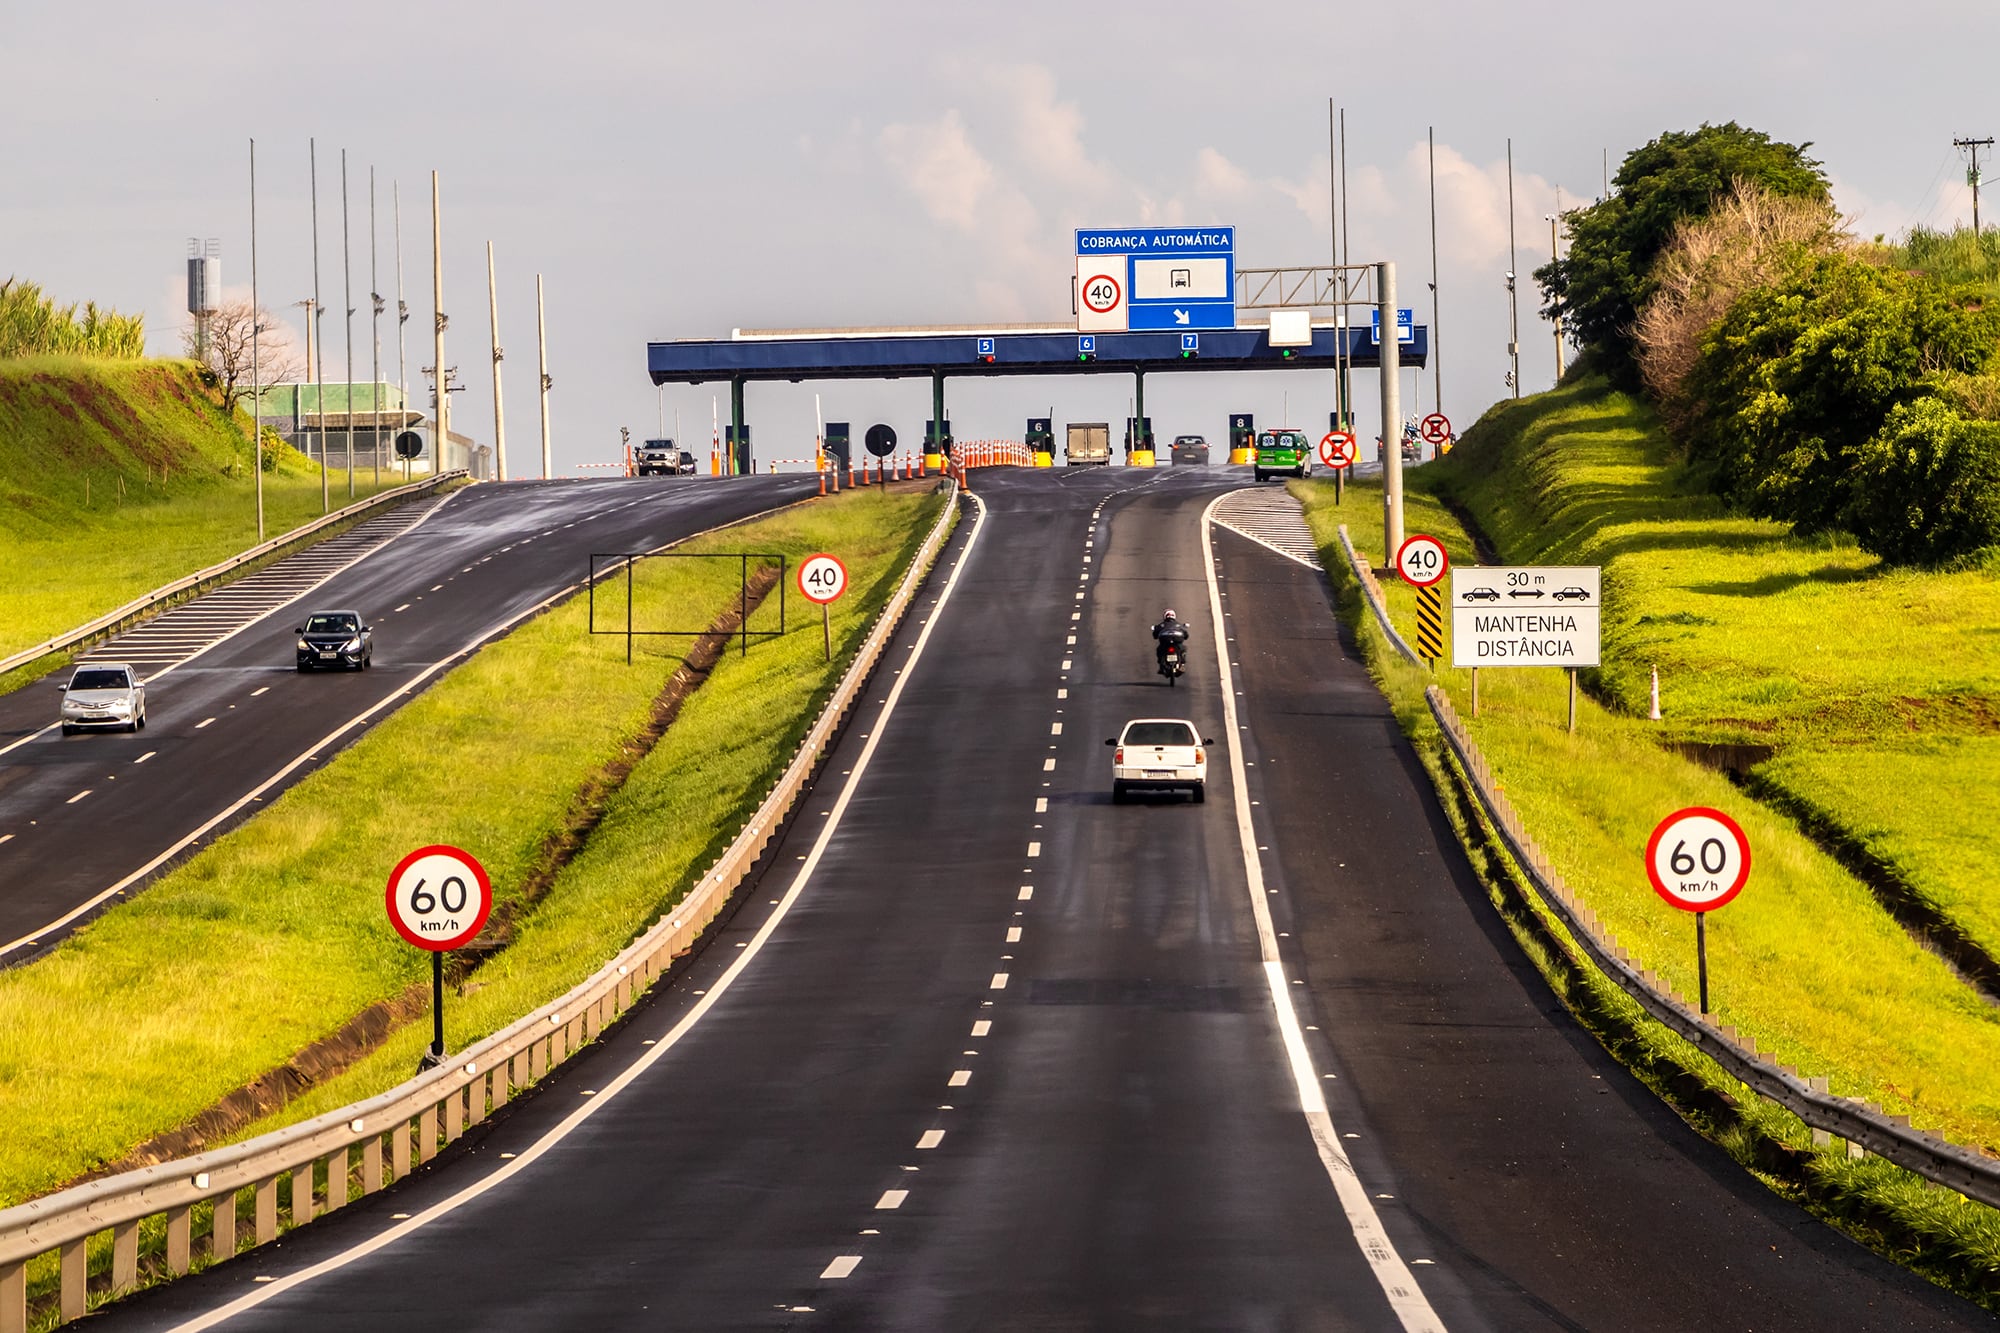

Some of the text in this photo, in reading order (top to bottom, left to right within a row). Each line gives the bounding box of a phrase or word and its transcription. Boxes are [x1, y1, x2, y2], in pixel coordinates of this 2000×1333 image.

[1081, 232, 1229, 249] COBRANÇA AUTOMÁTICA
[1091, 285, 1112, 299] 40
[982, 341, 990, 350] 5
[1083, 339, 1091, 348] 6
[1186, 336, 1194, 346] 7
[1034, 422, 1043, 432] 6
[1236, 418, 1245, 428] 8
[1408, 550, 1437, 569] 40
[808, 568, 836, 586] 40
[1506, 572, 1545, 586] 30 m
[1475, 615, 1577, 632] MANTENHA
[1477, 636, 1574, 656] DISTÂNCIA
[1670, 837, 1726, 875] 60
[1680, 880, 1719, 892] km/h
[410, 876, 467, 914] 60
[420, 919, 459, 931] km/h
